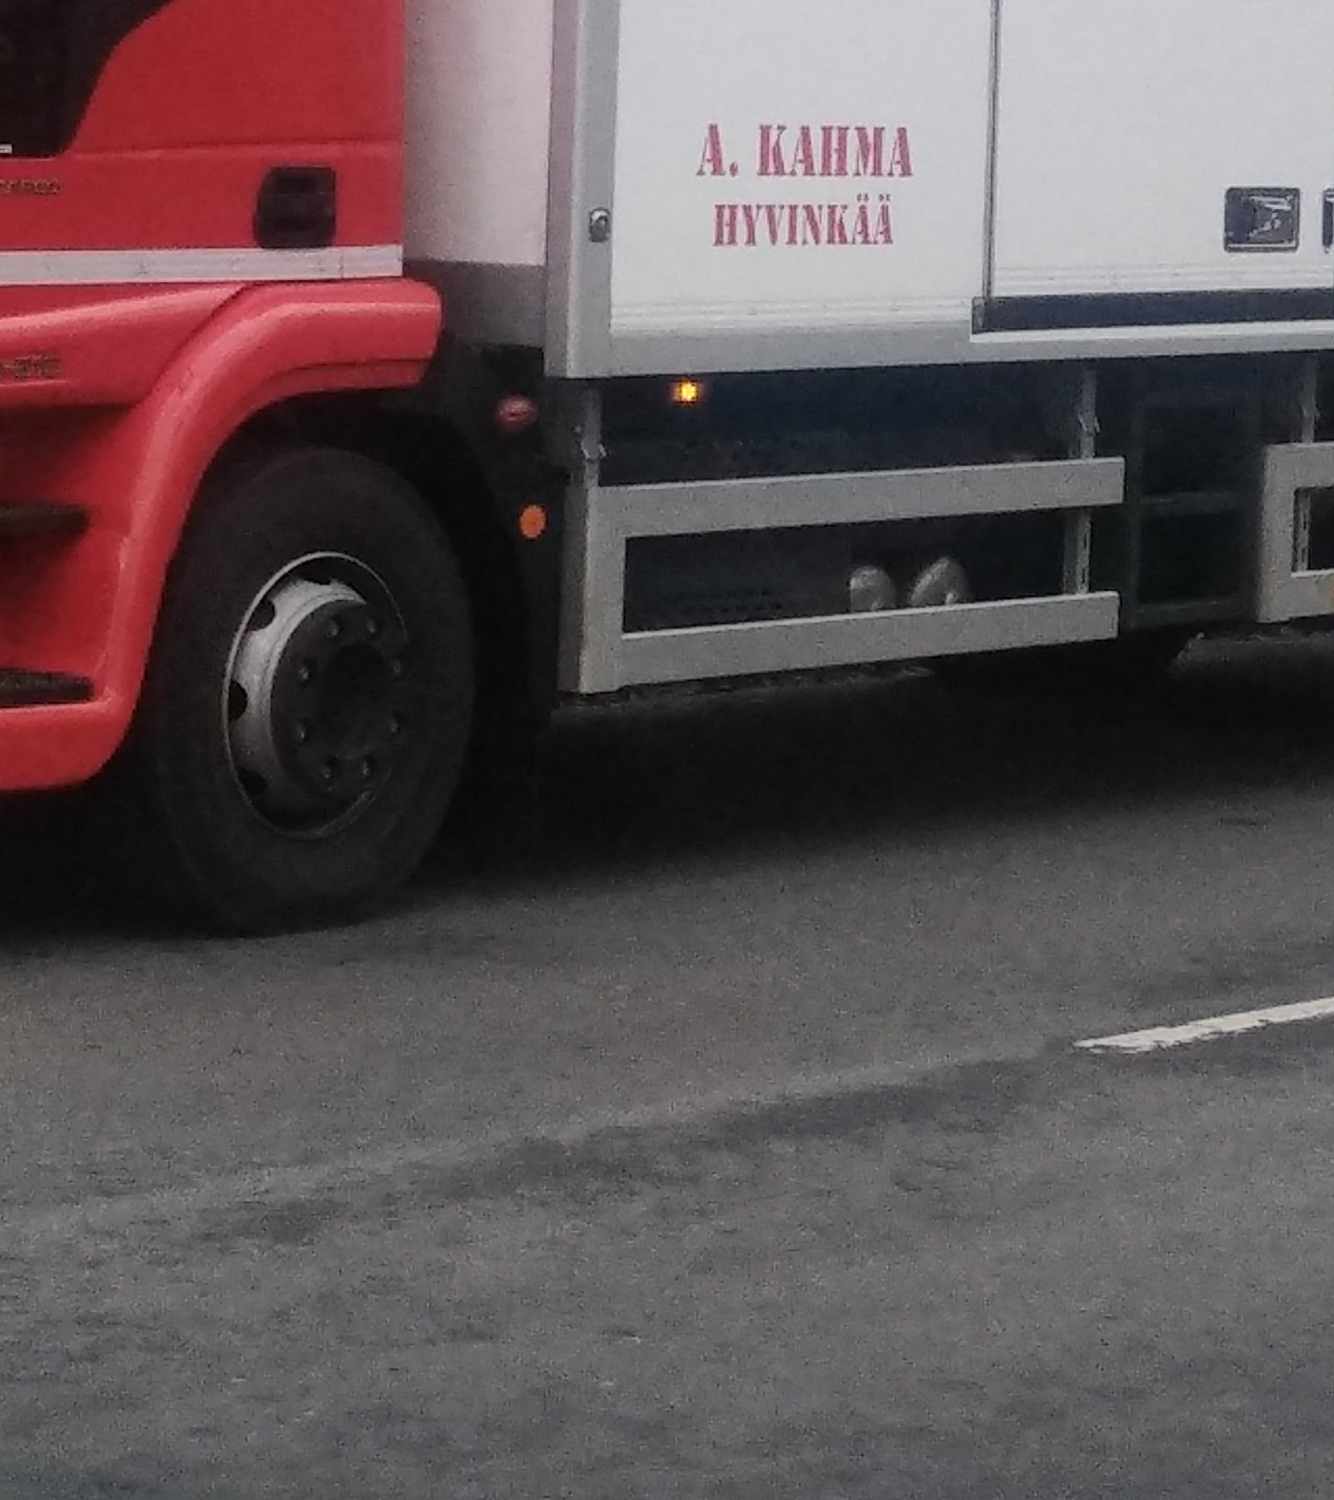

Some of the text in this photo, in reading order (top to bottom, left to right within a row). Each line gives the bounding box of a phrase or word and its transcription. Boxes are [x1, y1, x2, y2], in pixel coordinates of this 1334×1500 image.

[695, 123, 914, 178] A. KAHMA
[713, 192, 894, 247] HYVINKÄÄ
